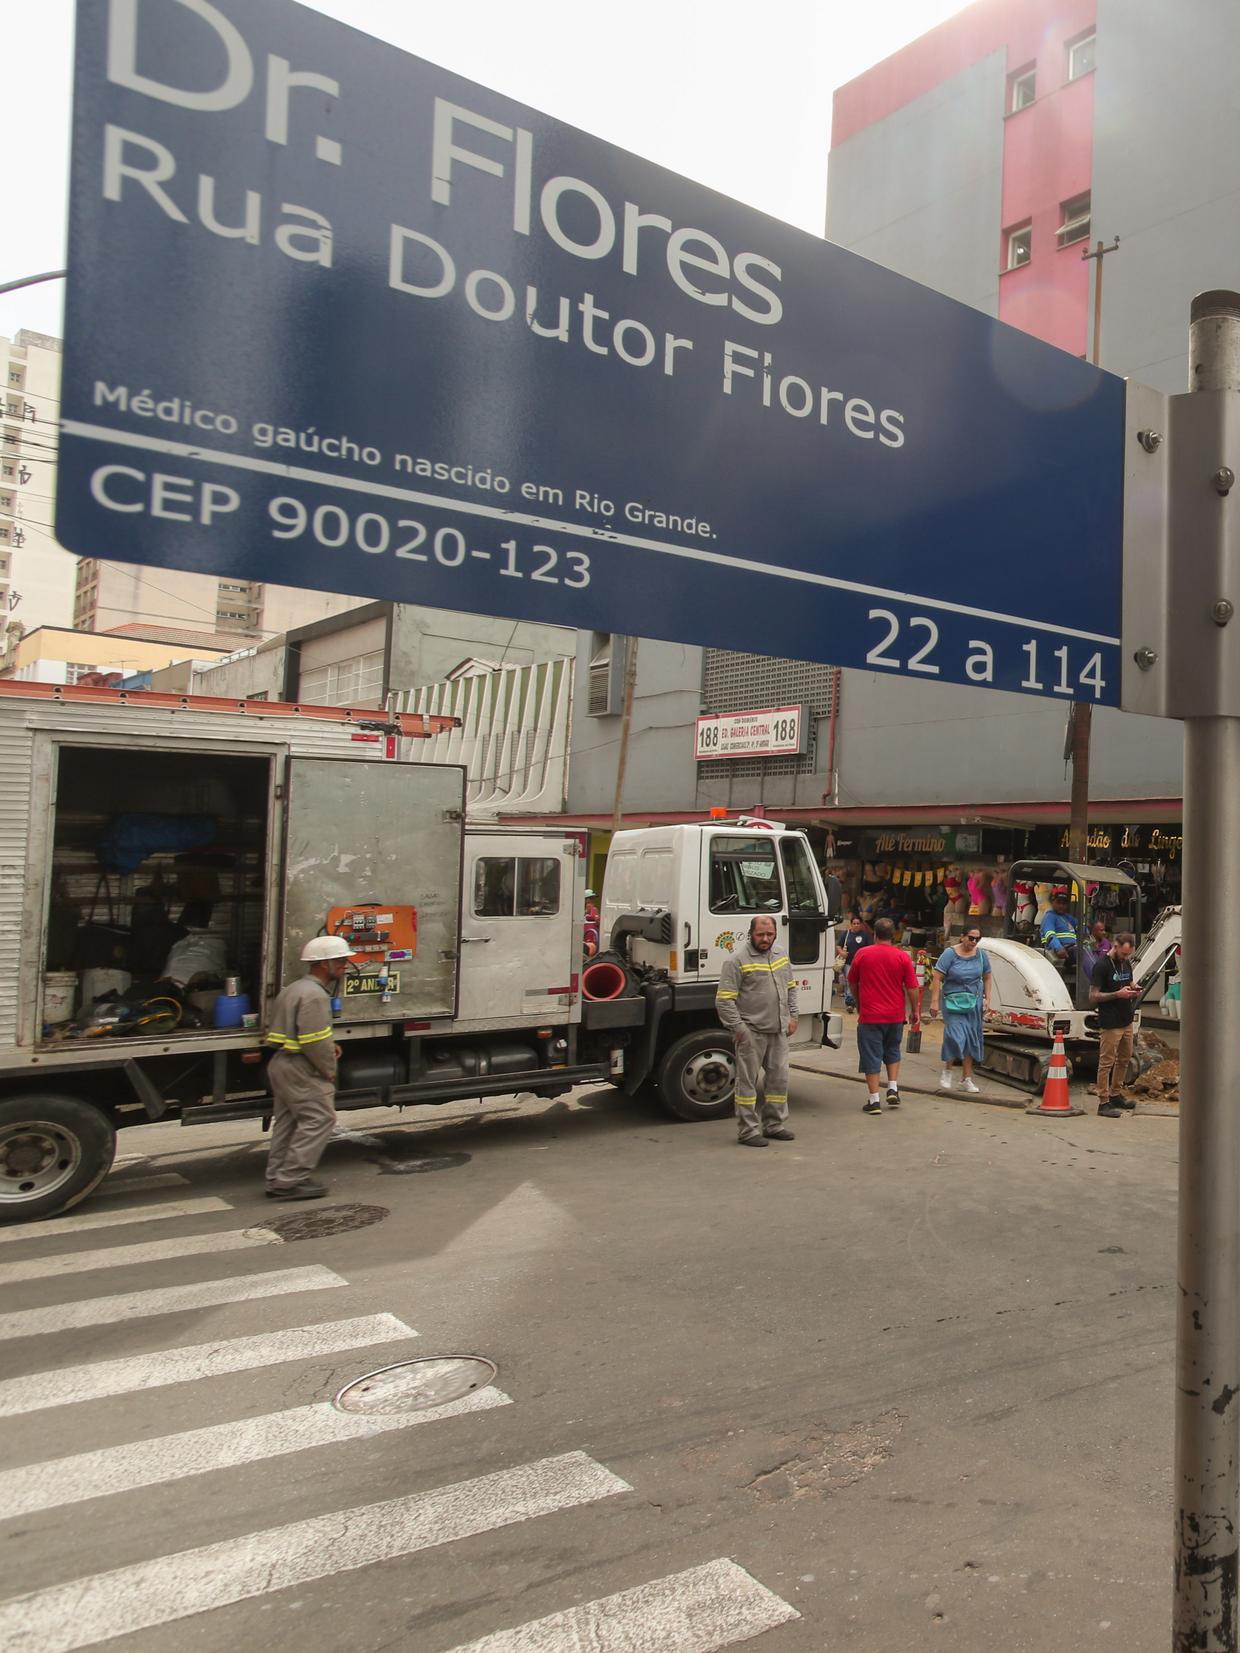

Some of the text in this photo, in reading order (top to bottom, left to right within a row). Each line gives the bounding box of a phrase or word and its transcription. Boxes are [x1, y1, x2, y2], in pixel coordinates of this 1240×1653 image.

[108, 0, 782, 324] Dr. Flores
[104, 125, 332, 267] Rua
[389, 224, 693, 375] Doutor
[95, 382, 716, 538] Médico gaúcho nascido em Rio Grande.
[91, 465, 590, 587] CEP 90020-123
[867, 609, 1105, 698] 22 a 114
[700, 727, 718, 748] 188
[774, 719, 795, 741] 188
